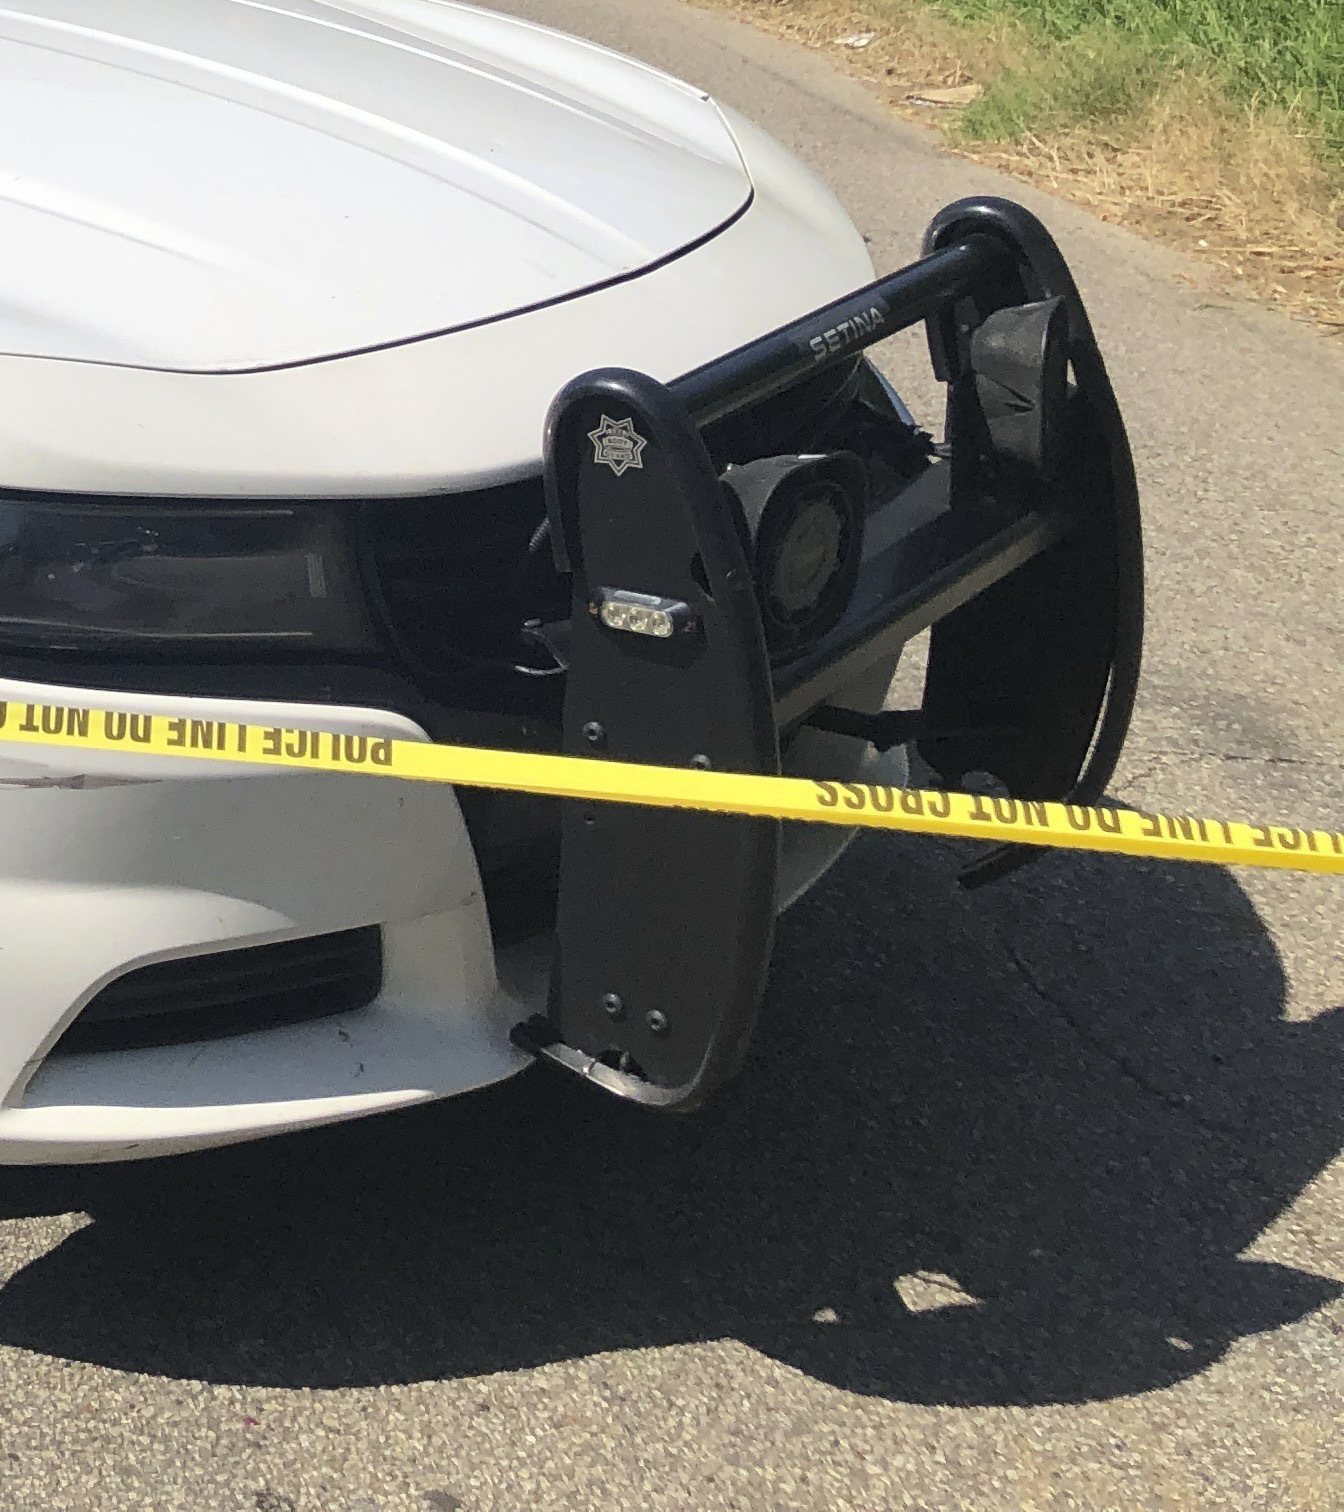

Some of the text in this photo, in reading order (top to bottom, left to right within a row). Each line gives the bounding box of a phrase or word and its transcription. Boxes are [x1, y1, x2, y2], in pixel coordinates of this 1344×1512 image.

[809, 306, 886, 361] SETINA
[18, 703, 90, 738] NOT
[104, 710, 154, 745] DO
[262, 727, 393, 767] POLICE
[812, 780, 952, 819] CROSS
[967, 794, 1050, 829] NOT
